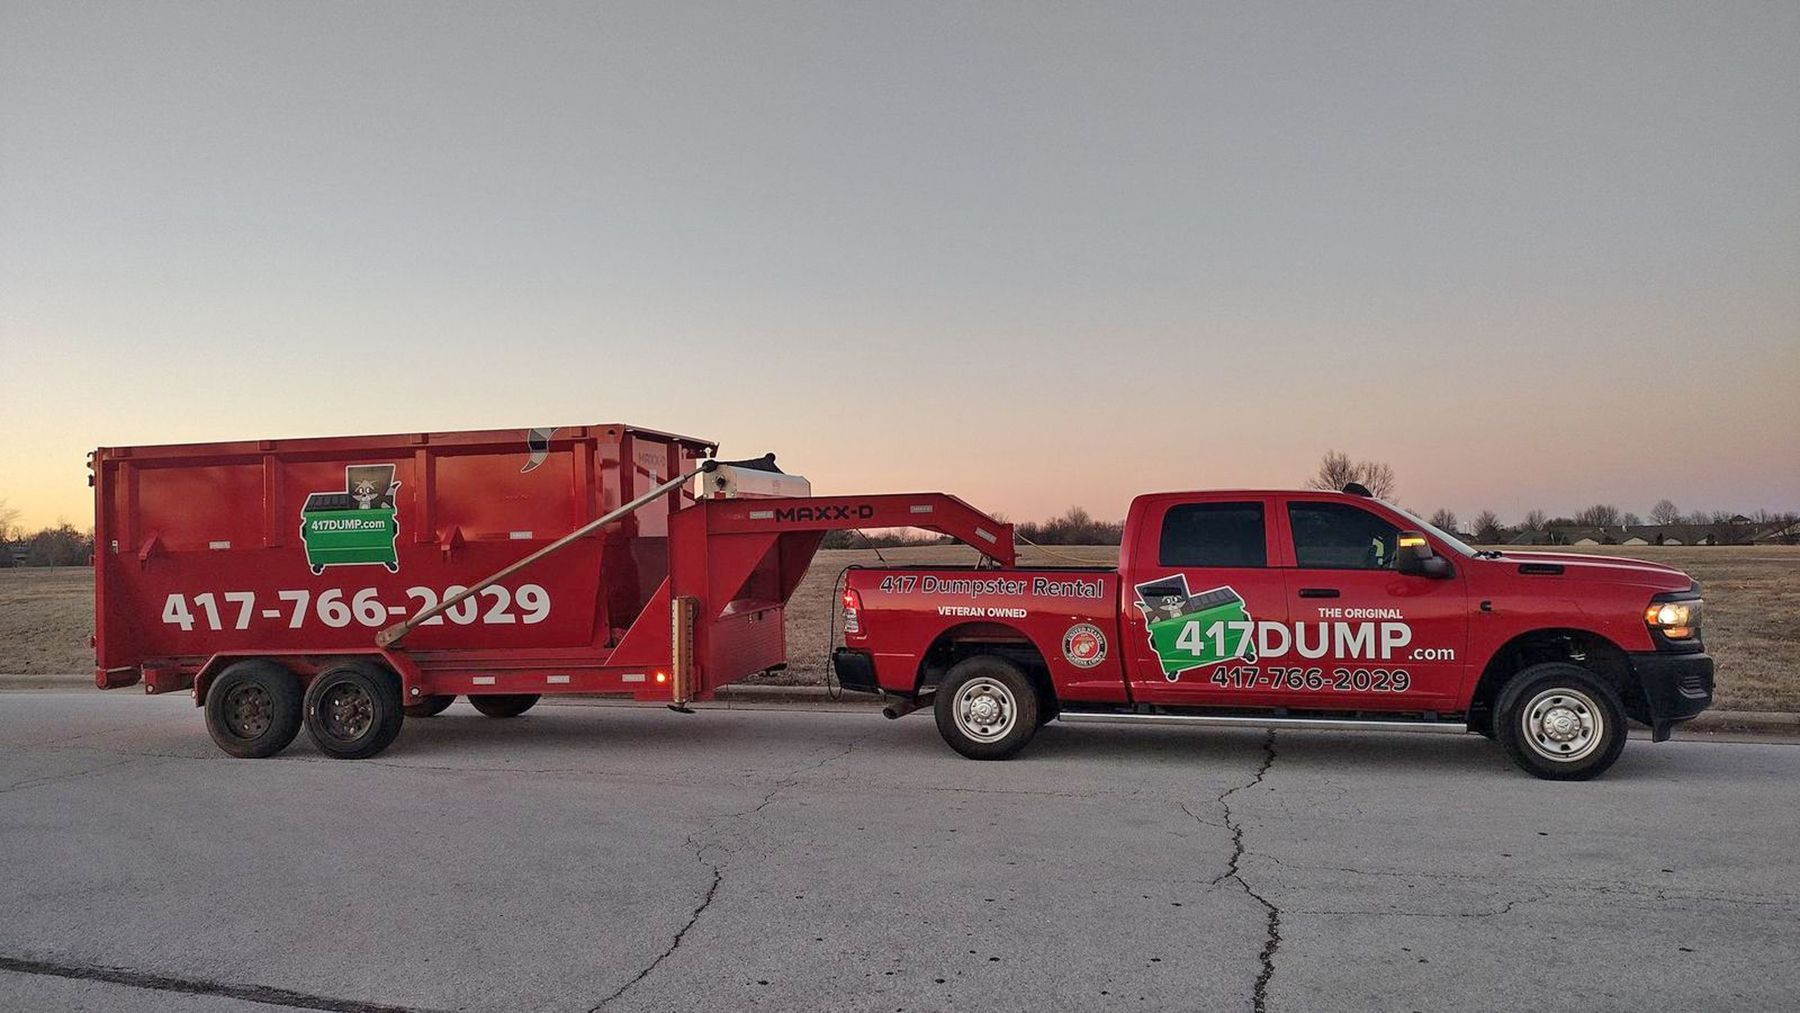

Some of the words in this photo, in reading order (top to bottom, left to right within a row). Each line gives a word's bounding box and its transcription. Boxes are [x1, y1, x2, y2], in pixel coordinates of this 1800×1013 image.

[776, 505, 874, 523] MAXX-D
[311, 519, 385, 530] 417DUMP.com
[880, 576, 918, 593] 417
[921, 576, 1027, 598] Dumpster
[1032, 576, 1104, 598] Rental
[161, 583, 551, 631] 417-766-2029
[937, 606, 985, 617] VETERAN
[987, 607, 1028, 618] OWNED
[1318, 608, 1342, 618] THE
[1344, 608, 1404, 619] ORIGINAL
[1210, 666, 1411, 692] 417-766-2029
